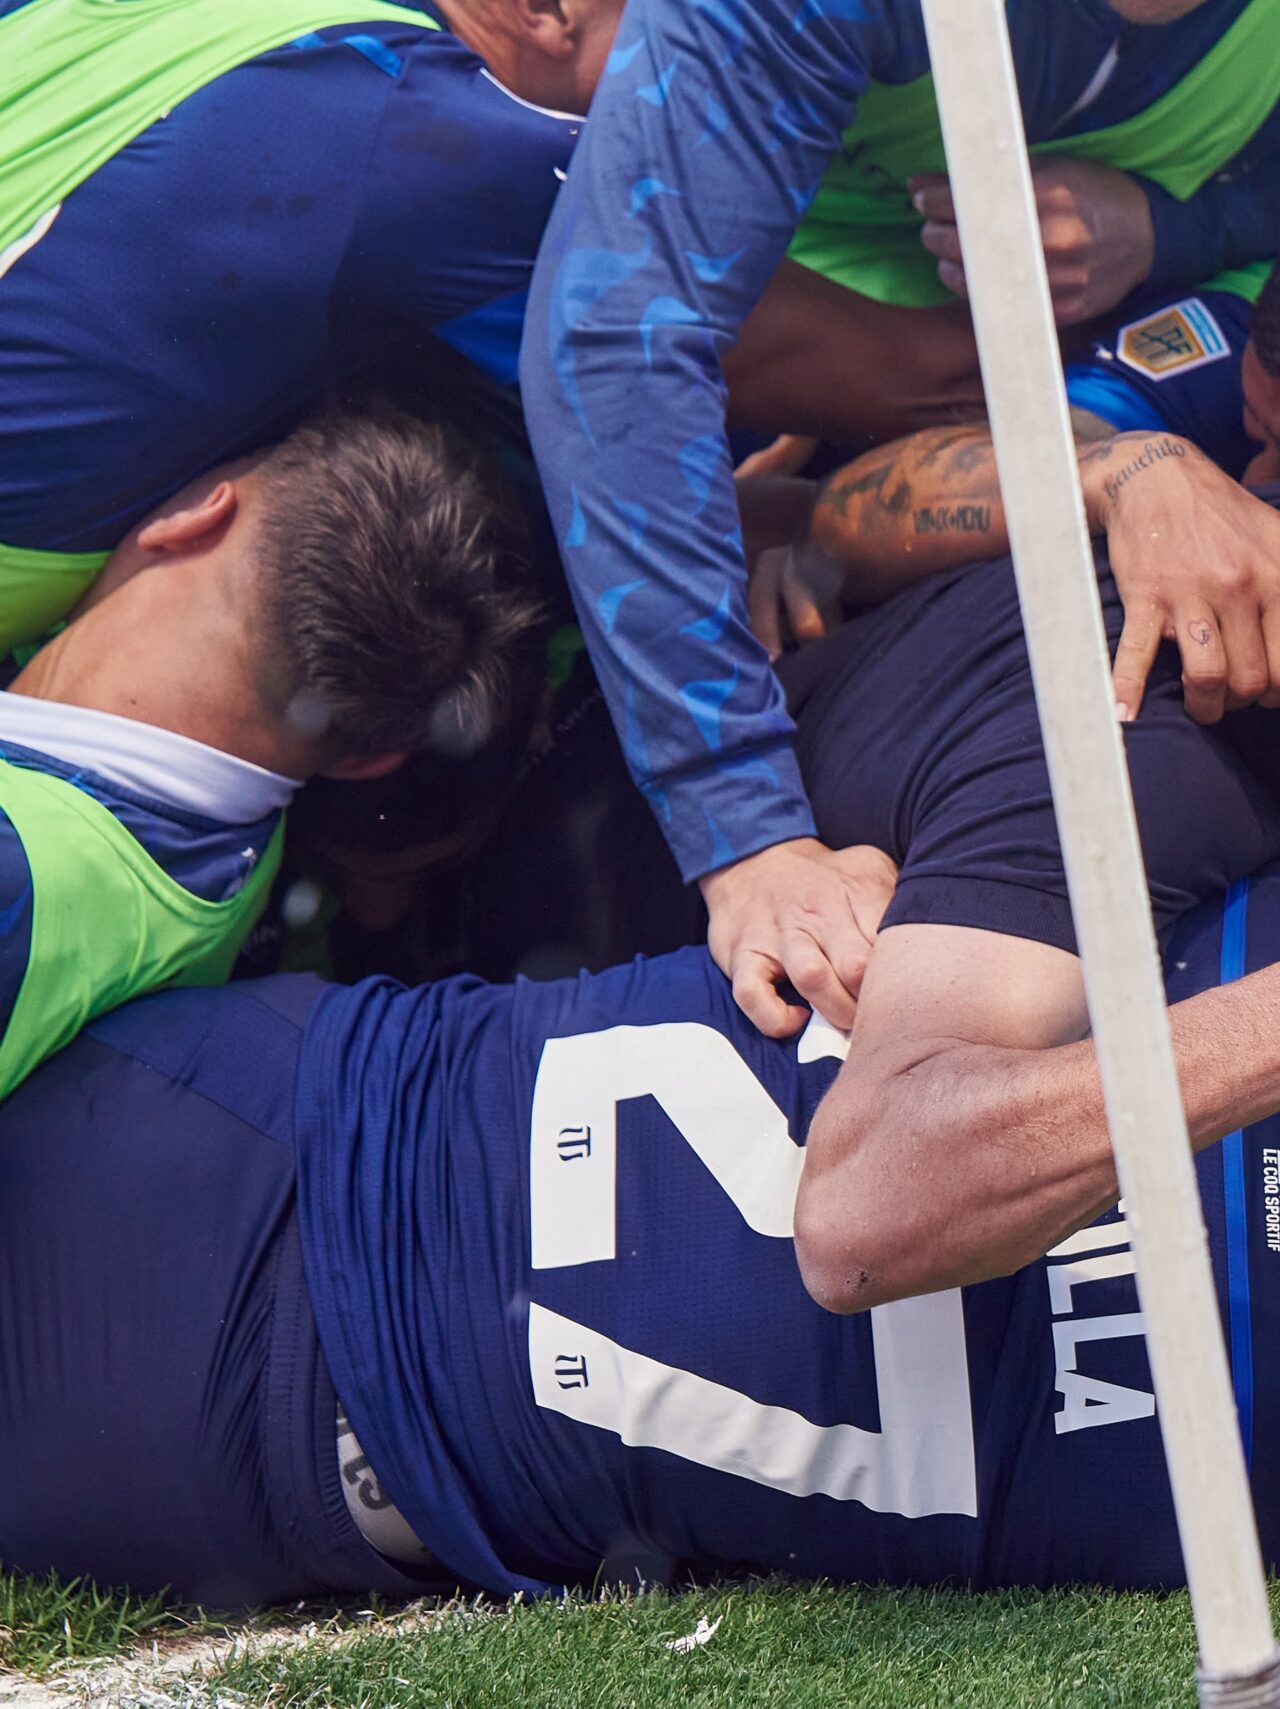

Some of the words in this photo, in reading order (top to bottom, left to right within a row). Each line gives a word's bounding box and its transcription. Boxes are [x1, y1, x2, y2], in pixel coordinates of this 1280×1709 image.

[1263, 1148, 1278, 1164] LE
[1263, 1166, 1280, 1194] COQ
[1264, 1196, 1280, 1252] SPORTIF
